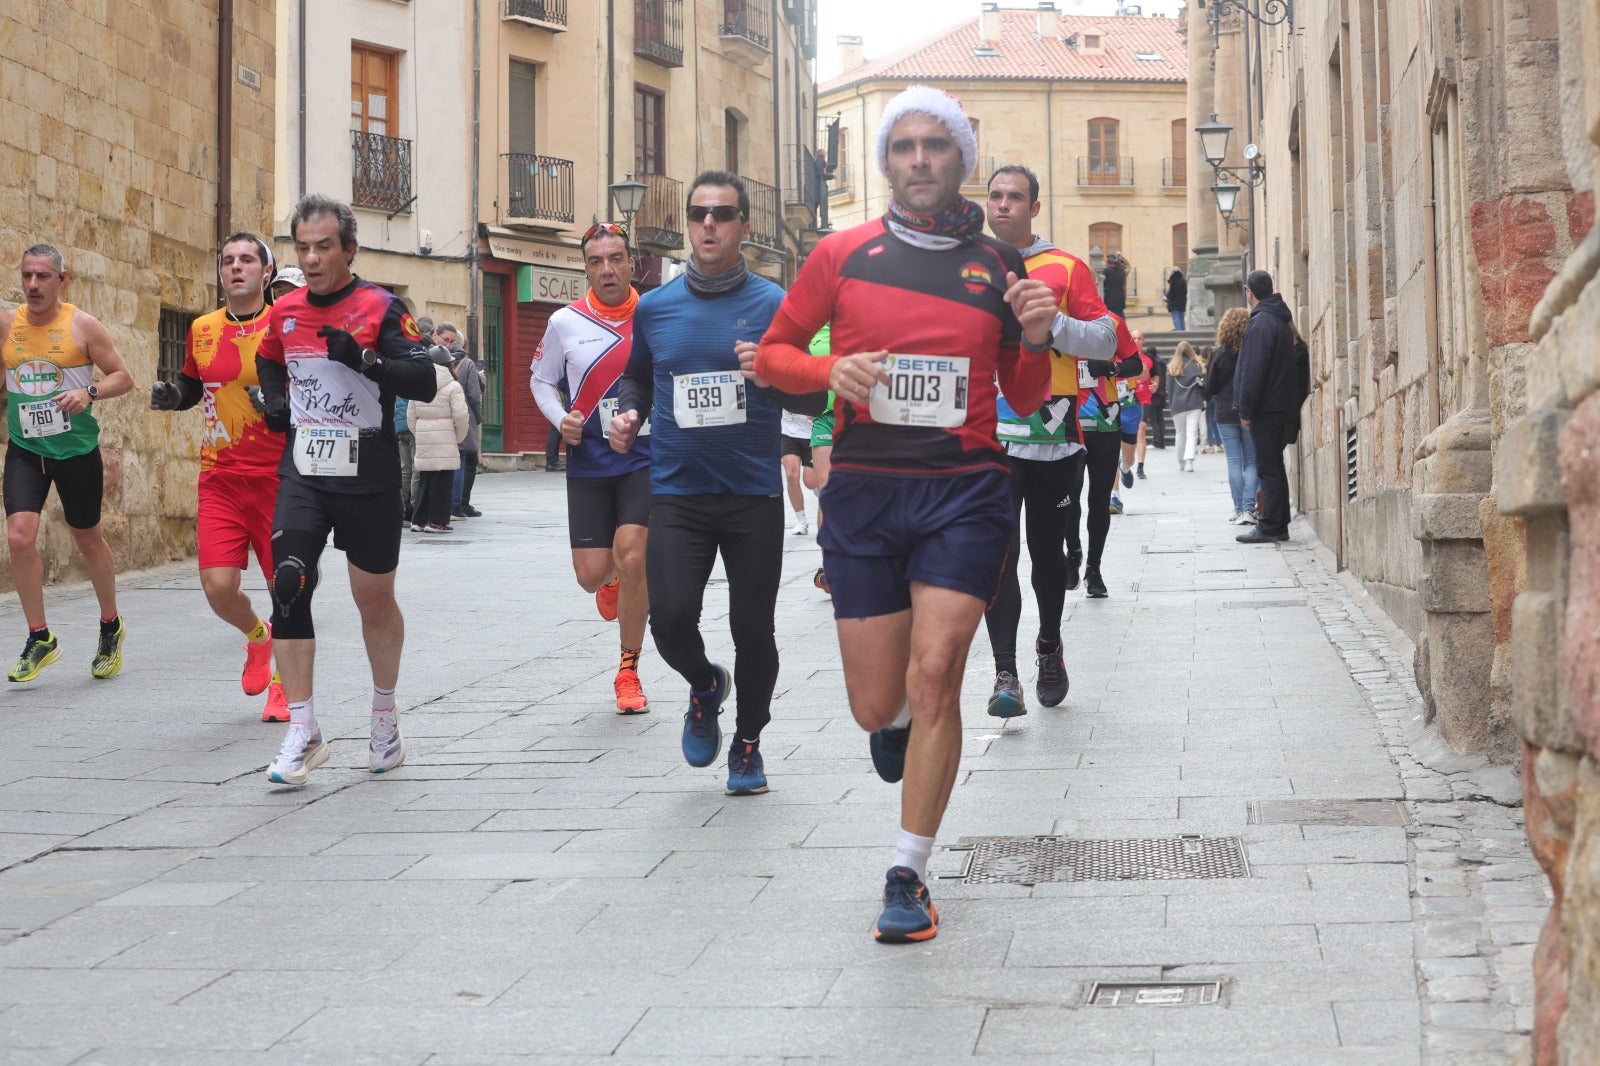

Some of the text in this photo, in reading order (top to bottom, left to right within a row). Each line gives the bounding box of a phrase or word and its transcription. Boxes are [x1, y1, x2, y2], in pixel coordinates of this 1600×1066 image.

[506, 247, 523, 257] away
[532, 249, 544, 258] café
[539, 276, 580, 301] SCALE
[898, 359, 958, 373] SETEL
[19, 372, 58, 384] ALCER
[690, 374, 737, 386] SETEL
[888, 373, 940, 402] 1003
[301, 389, 360, 419] Martín
[687, 386, 722, 409] 939
[29, 409, 53, 425] 760
[310, 429, 352, 438] SETEL
[306, 439, 336, 459] 477
